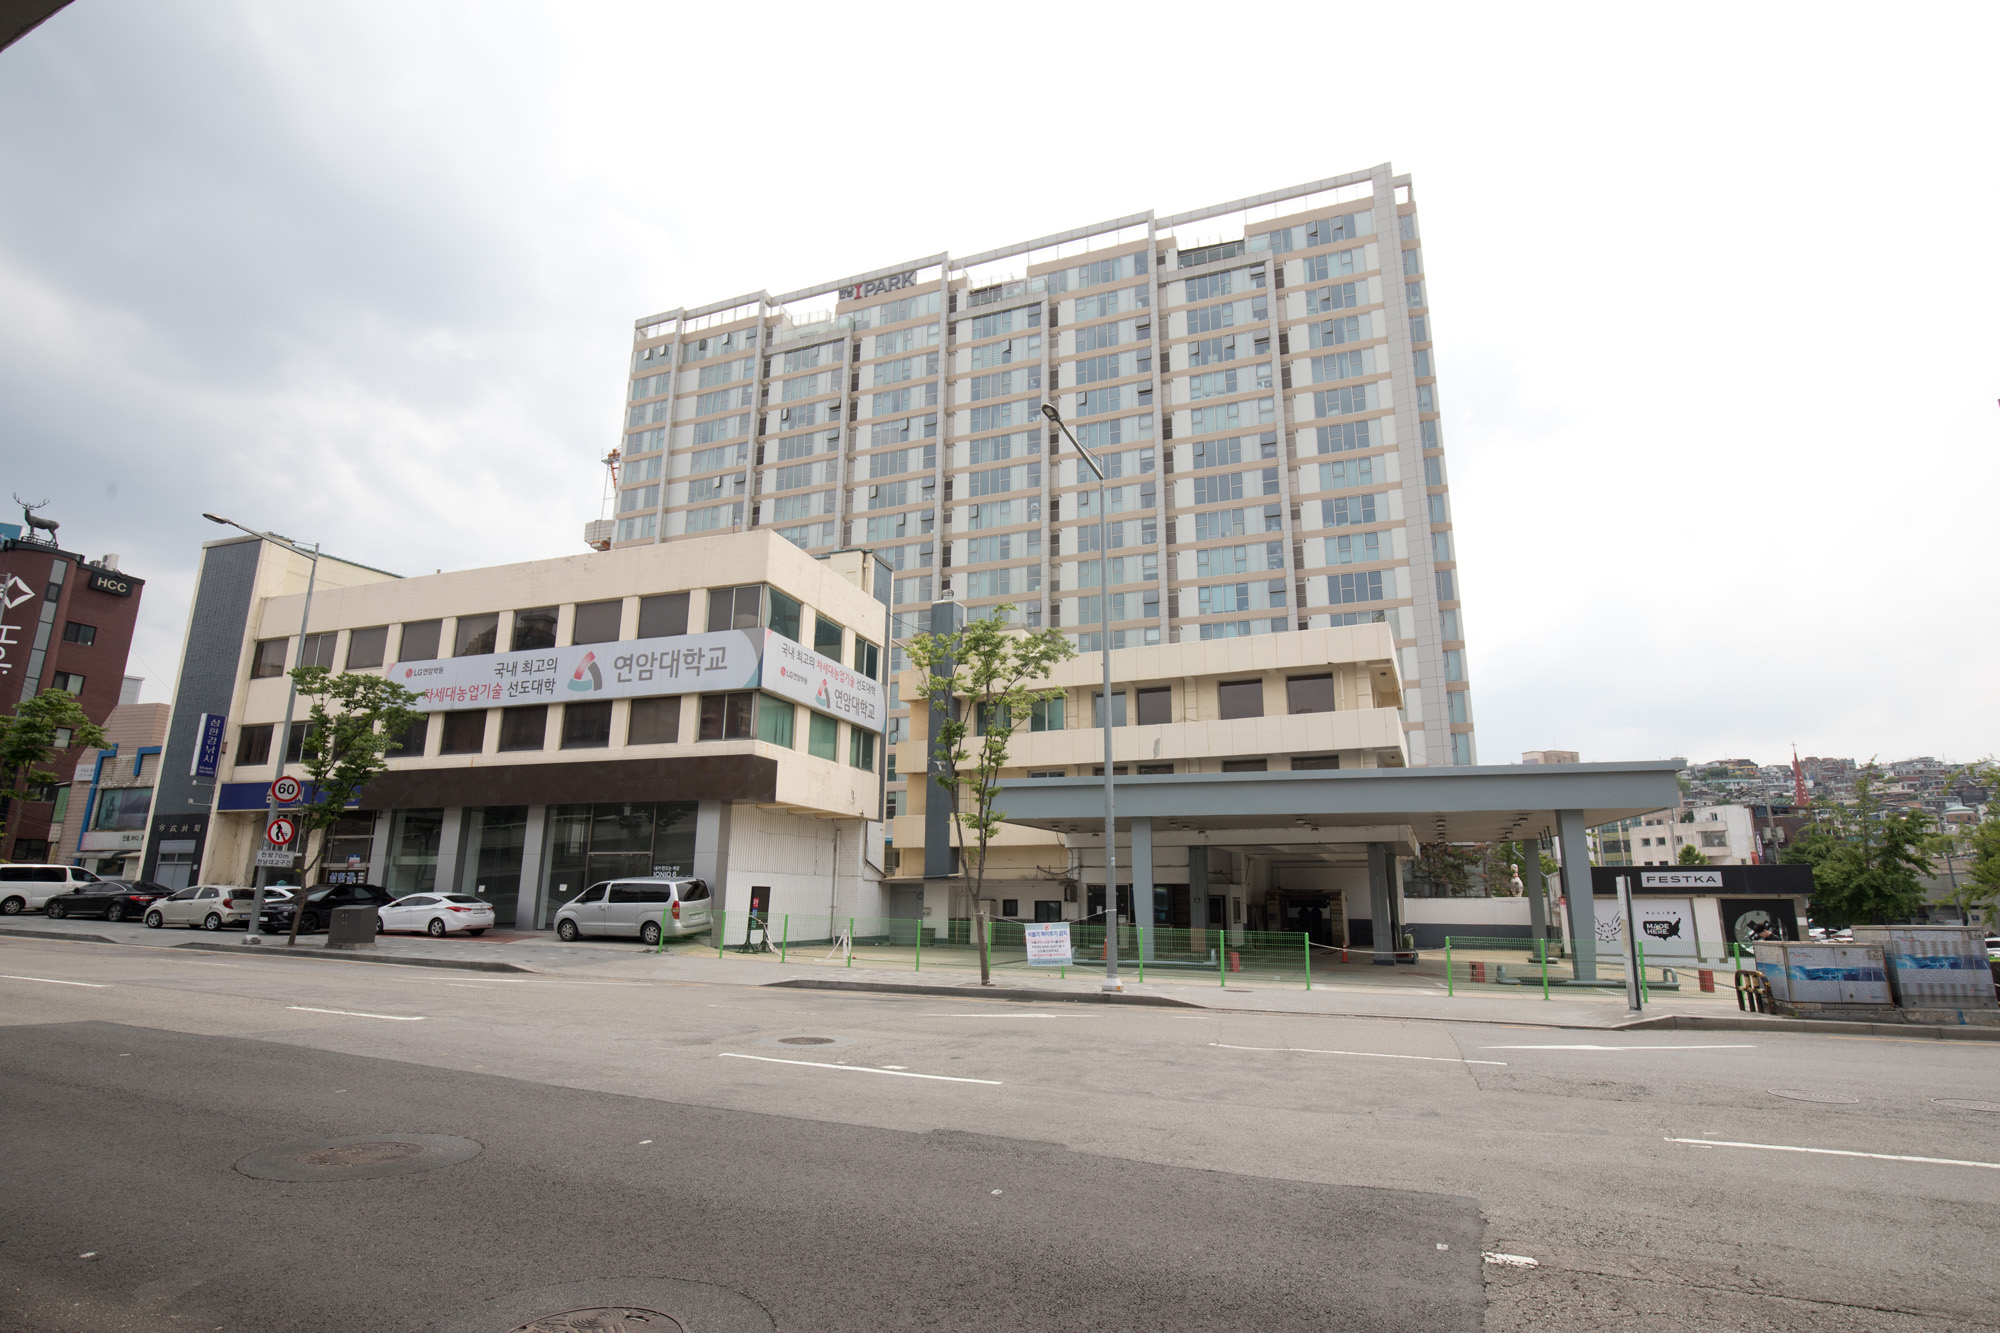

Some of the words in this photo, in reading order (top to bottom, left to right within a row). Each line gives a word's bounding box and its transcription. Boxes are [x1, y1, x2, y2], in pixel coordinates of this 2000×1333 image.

[864, 270, 915, 298] PARK
[97, 577, 127, 593] HCC
[494, 661, 518, 679] 국내
[521, 657, 558, 676] 최고의
[614, 646, 728, 683] 연암대학교
[782, 643, 795, 660] 국내
[797, 650, 815, 669] 최고의
[817, 659, 855, 688] 차세대농업기술
[856, 679, 876, 697] 선도대학
[423, 682, 503, 703] 차세대농업기술
[507, 678, 557, 698] 선도대학
[834, 689, 876, 720] 연암대학교
[278, 783, 295, 795] 60
